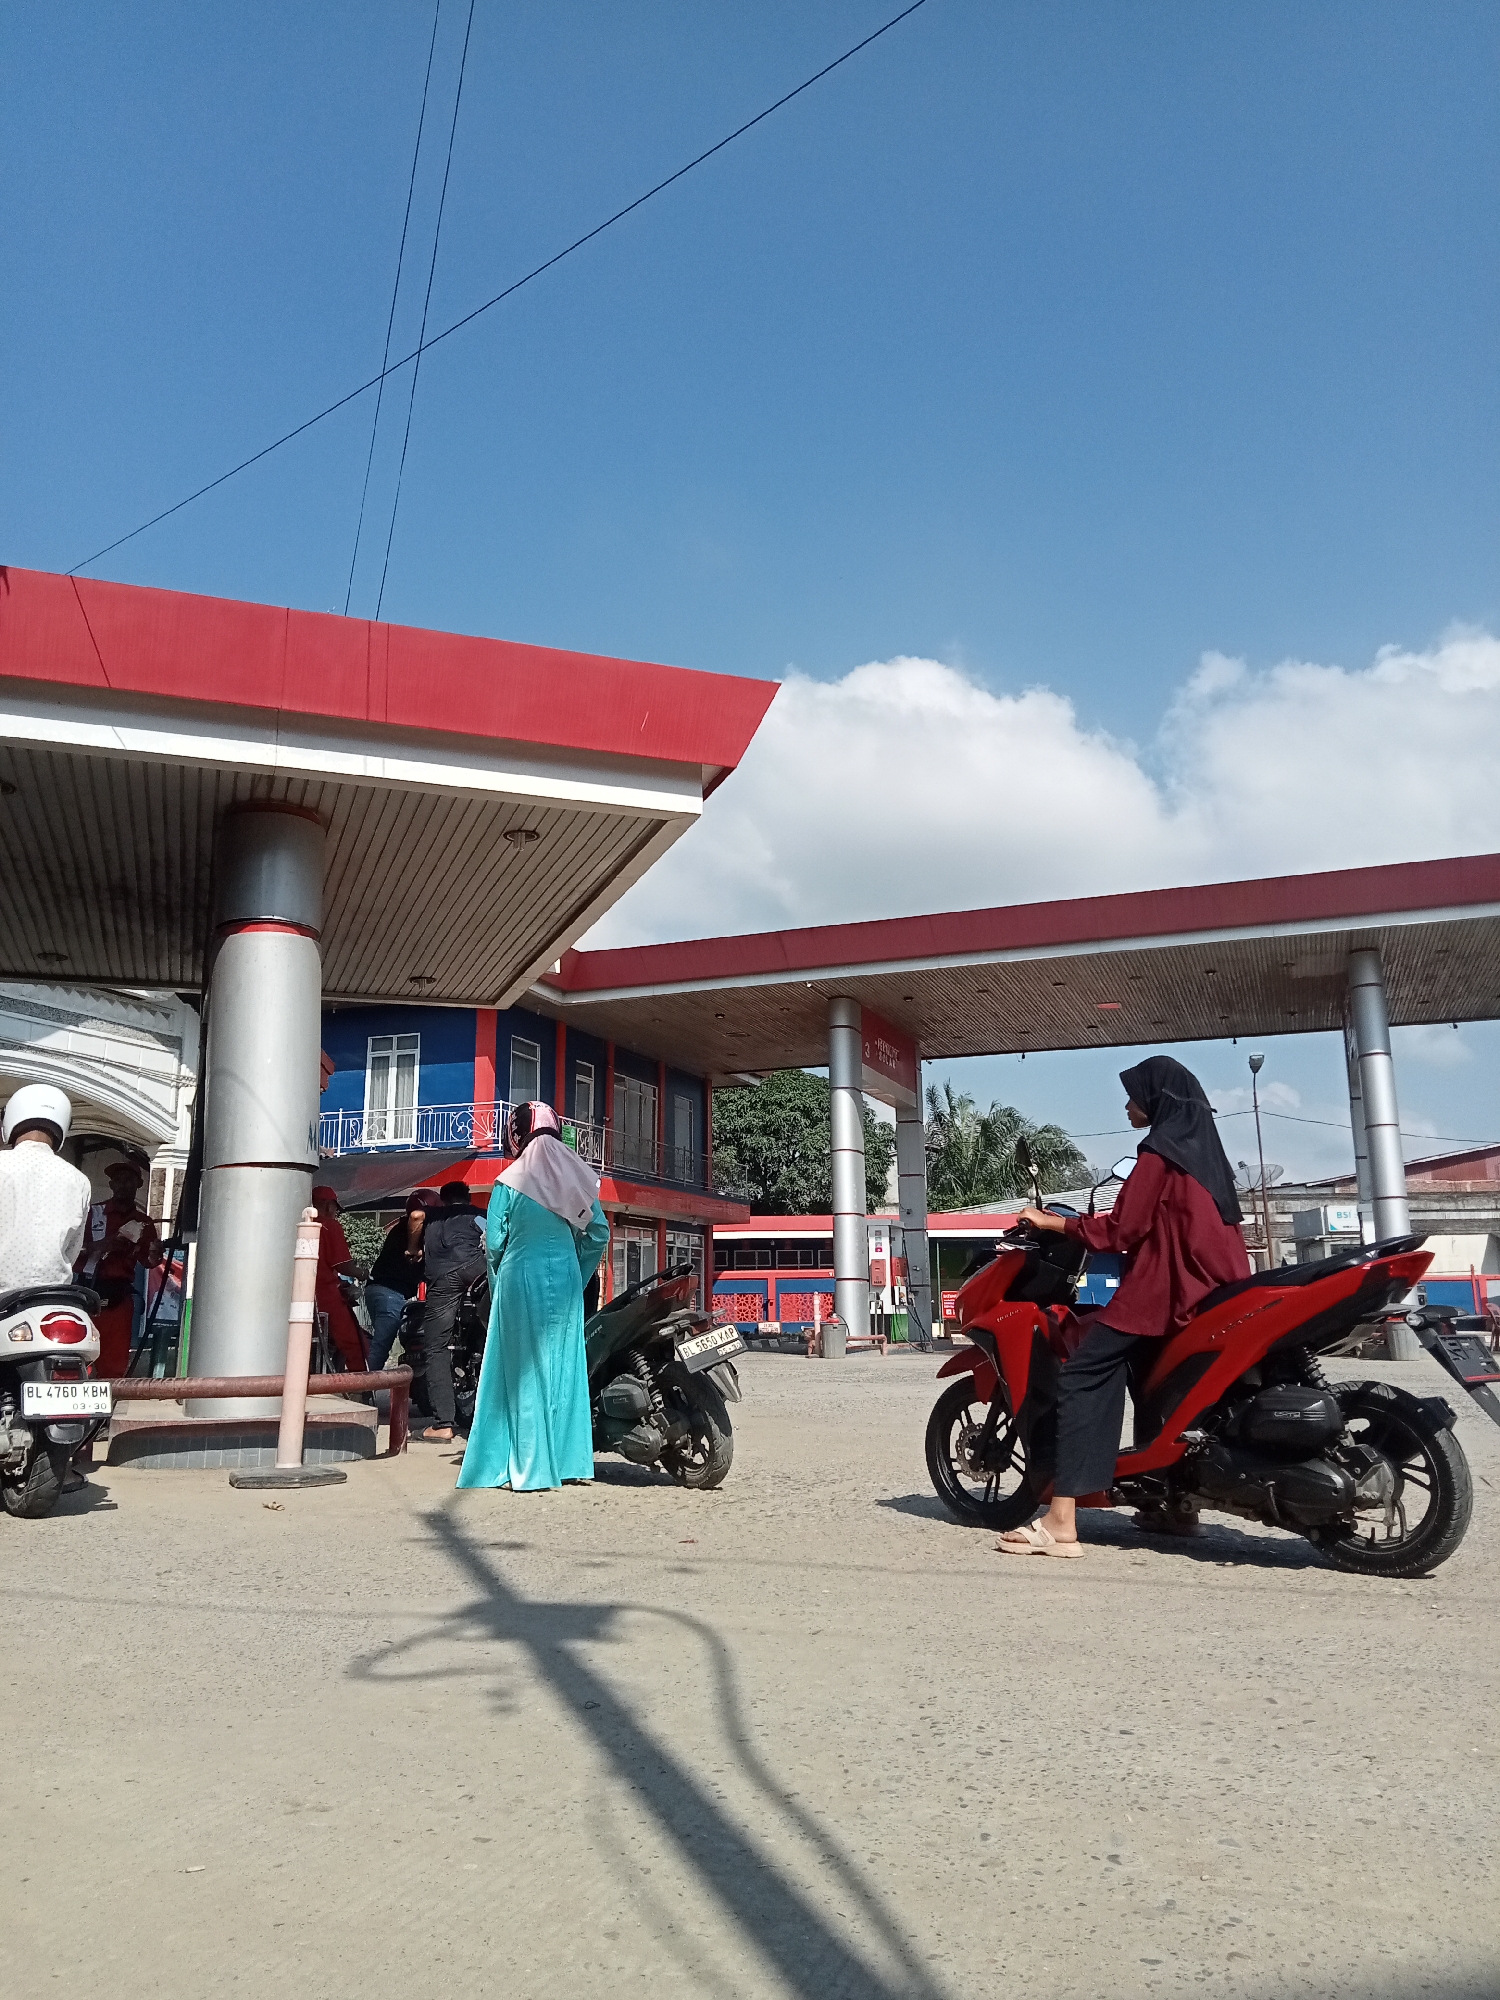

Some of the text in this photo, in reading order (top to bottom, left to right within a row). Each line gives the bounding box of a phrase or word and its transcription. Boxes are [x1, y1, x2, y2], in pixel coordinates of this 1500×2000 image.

[864, 1041, 870, 1059] 3
[682, 1327, 735, 1358] BL 5650 KAP
[27, 1385, 108, 1399] BL 4760 KBM
